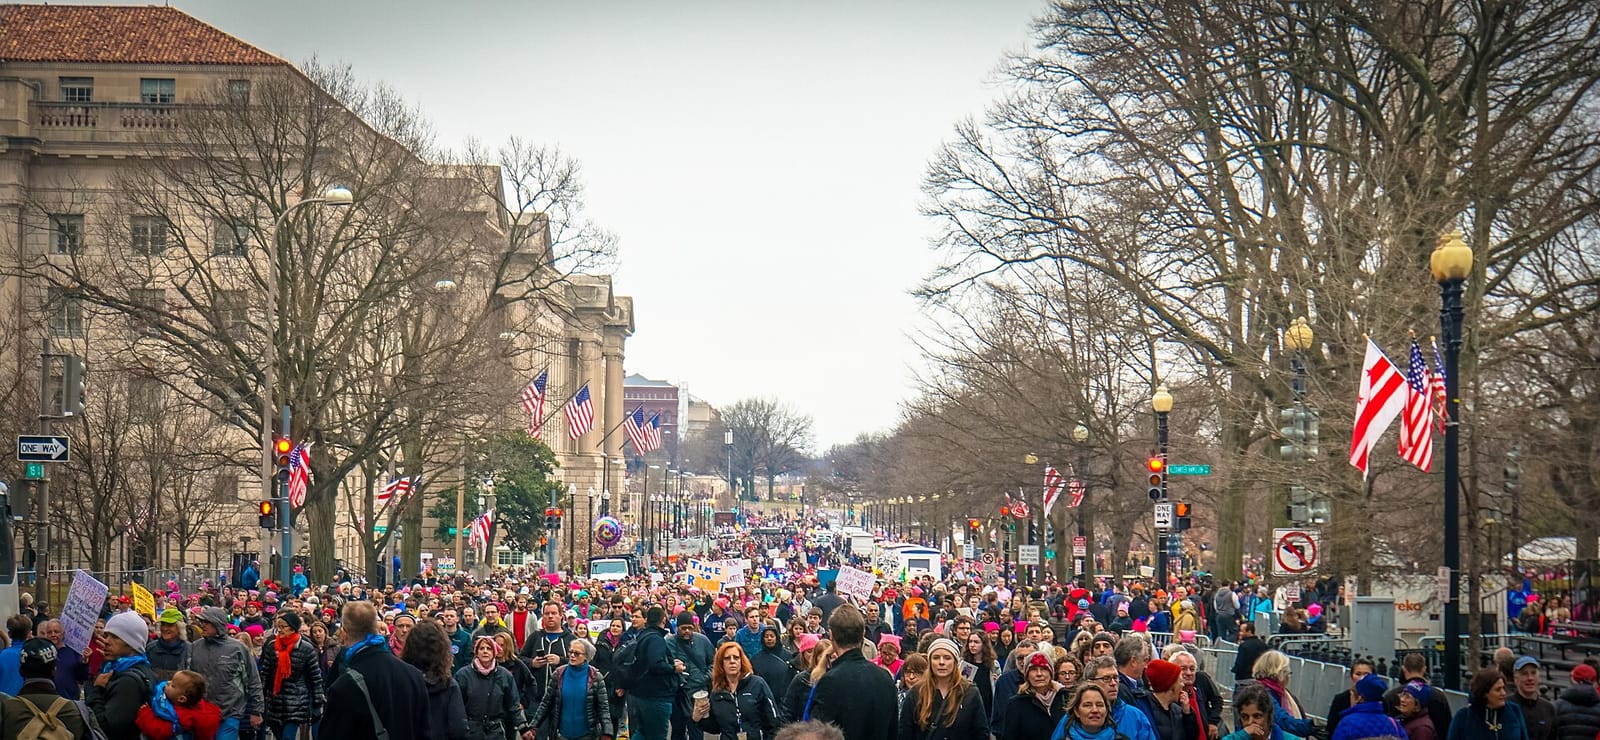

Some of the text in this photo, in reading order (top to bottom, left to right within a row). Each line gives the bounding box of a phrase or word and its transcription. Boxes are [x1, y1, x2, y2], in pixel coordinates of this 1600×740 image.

[21, 444, 60, 453] ONE WAY
[690, 560, 721, 575] TIME
[1394, 599, 1421, 611] reka
